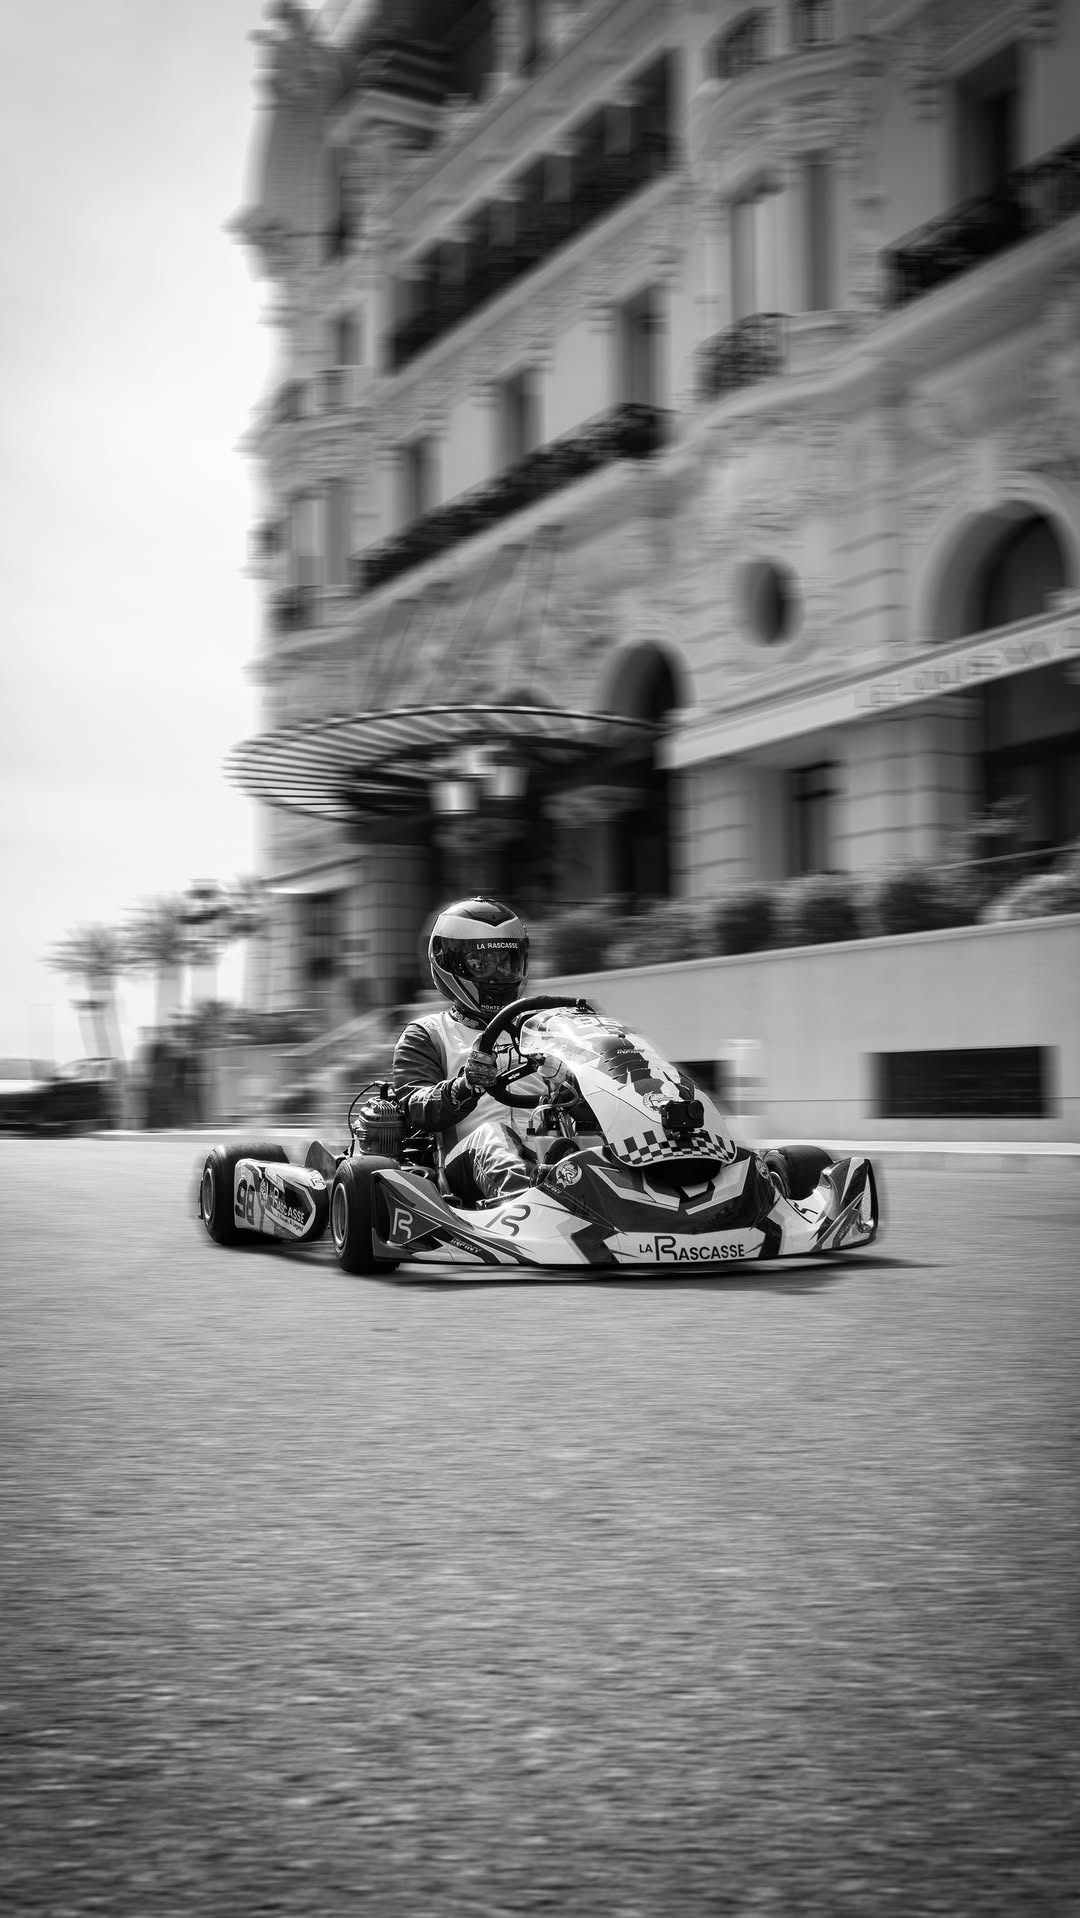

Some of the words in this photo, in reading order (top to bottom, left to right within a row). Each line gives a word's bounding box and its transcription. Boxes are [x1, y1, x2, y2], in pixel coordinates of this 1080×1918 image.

[235, 1178, 256, 1226] 98
[273, 1186, 305, 1224] RASCASSE
[392, 1207, 414, 1240] R
[639, 1244, 653, 1253] LA
[654, 1235, 745, 1261] RASCASSE
